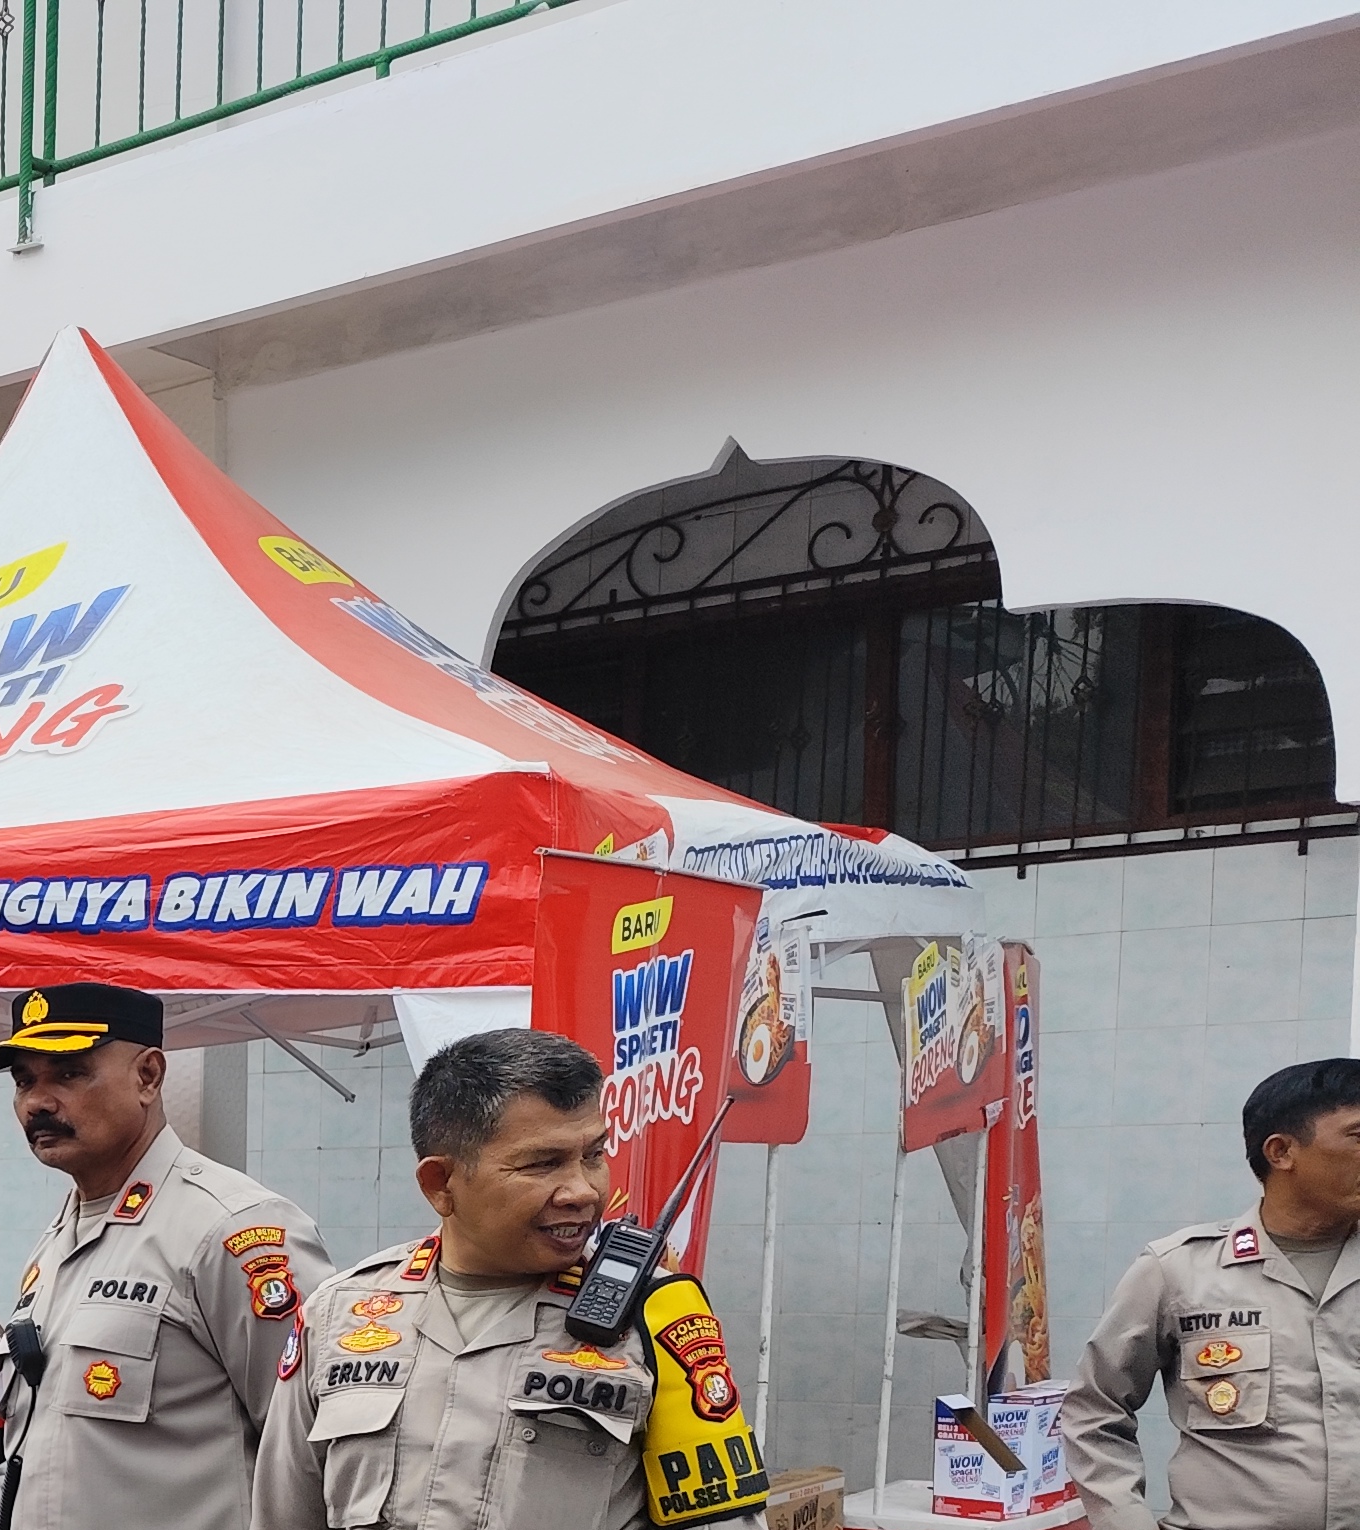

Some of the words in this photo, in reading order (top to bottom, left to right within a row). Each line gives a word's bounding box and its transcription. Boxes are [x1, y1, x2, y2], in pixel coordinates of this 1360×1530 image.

[157, 870, 328, 924] BIKIN
[336, 864, 484, 917] WAH
[615, 953, 692, 1033] WOW
[917, 970, 947, 1027] WOW
[912, 1025, 956, 1100] GORENG
[88, 1279, 159, 1304] POLRI
[667, 1317, 719, 1344] POLSEK
[327, 1360, 400, 1387] ERLYN
[523, 1371, 627, 1412] POLRI
[993, 1409, 1028, 1423] WOW
[950, 1454, 983, 1469] WOW
[659, 1482, 732, 1516] POLSEK
